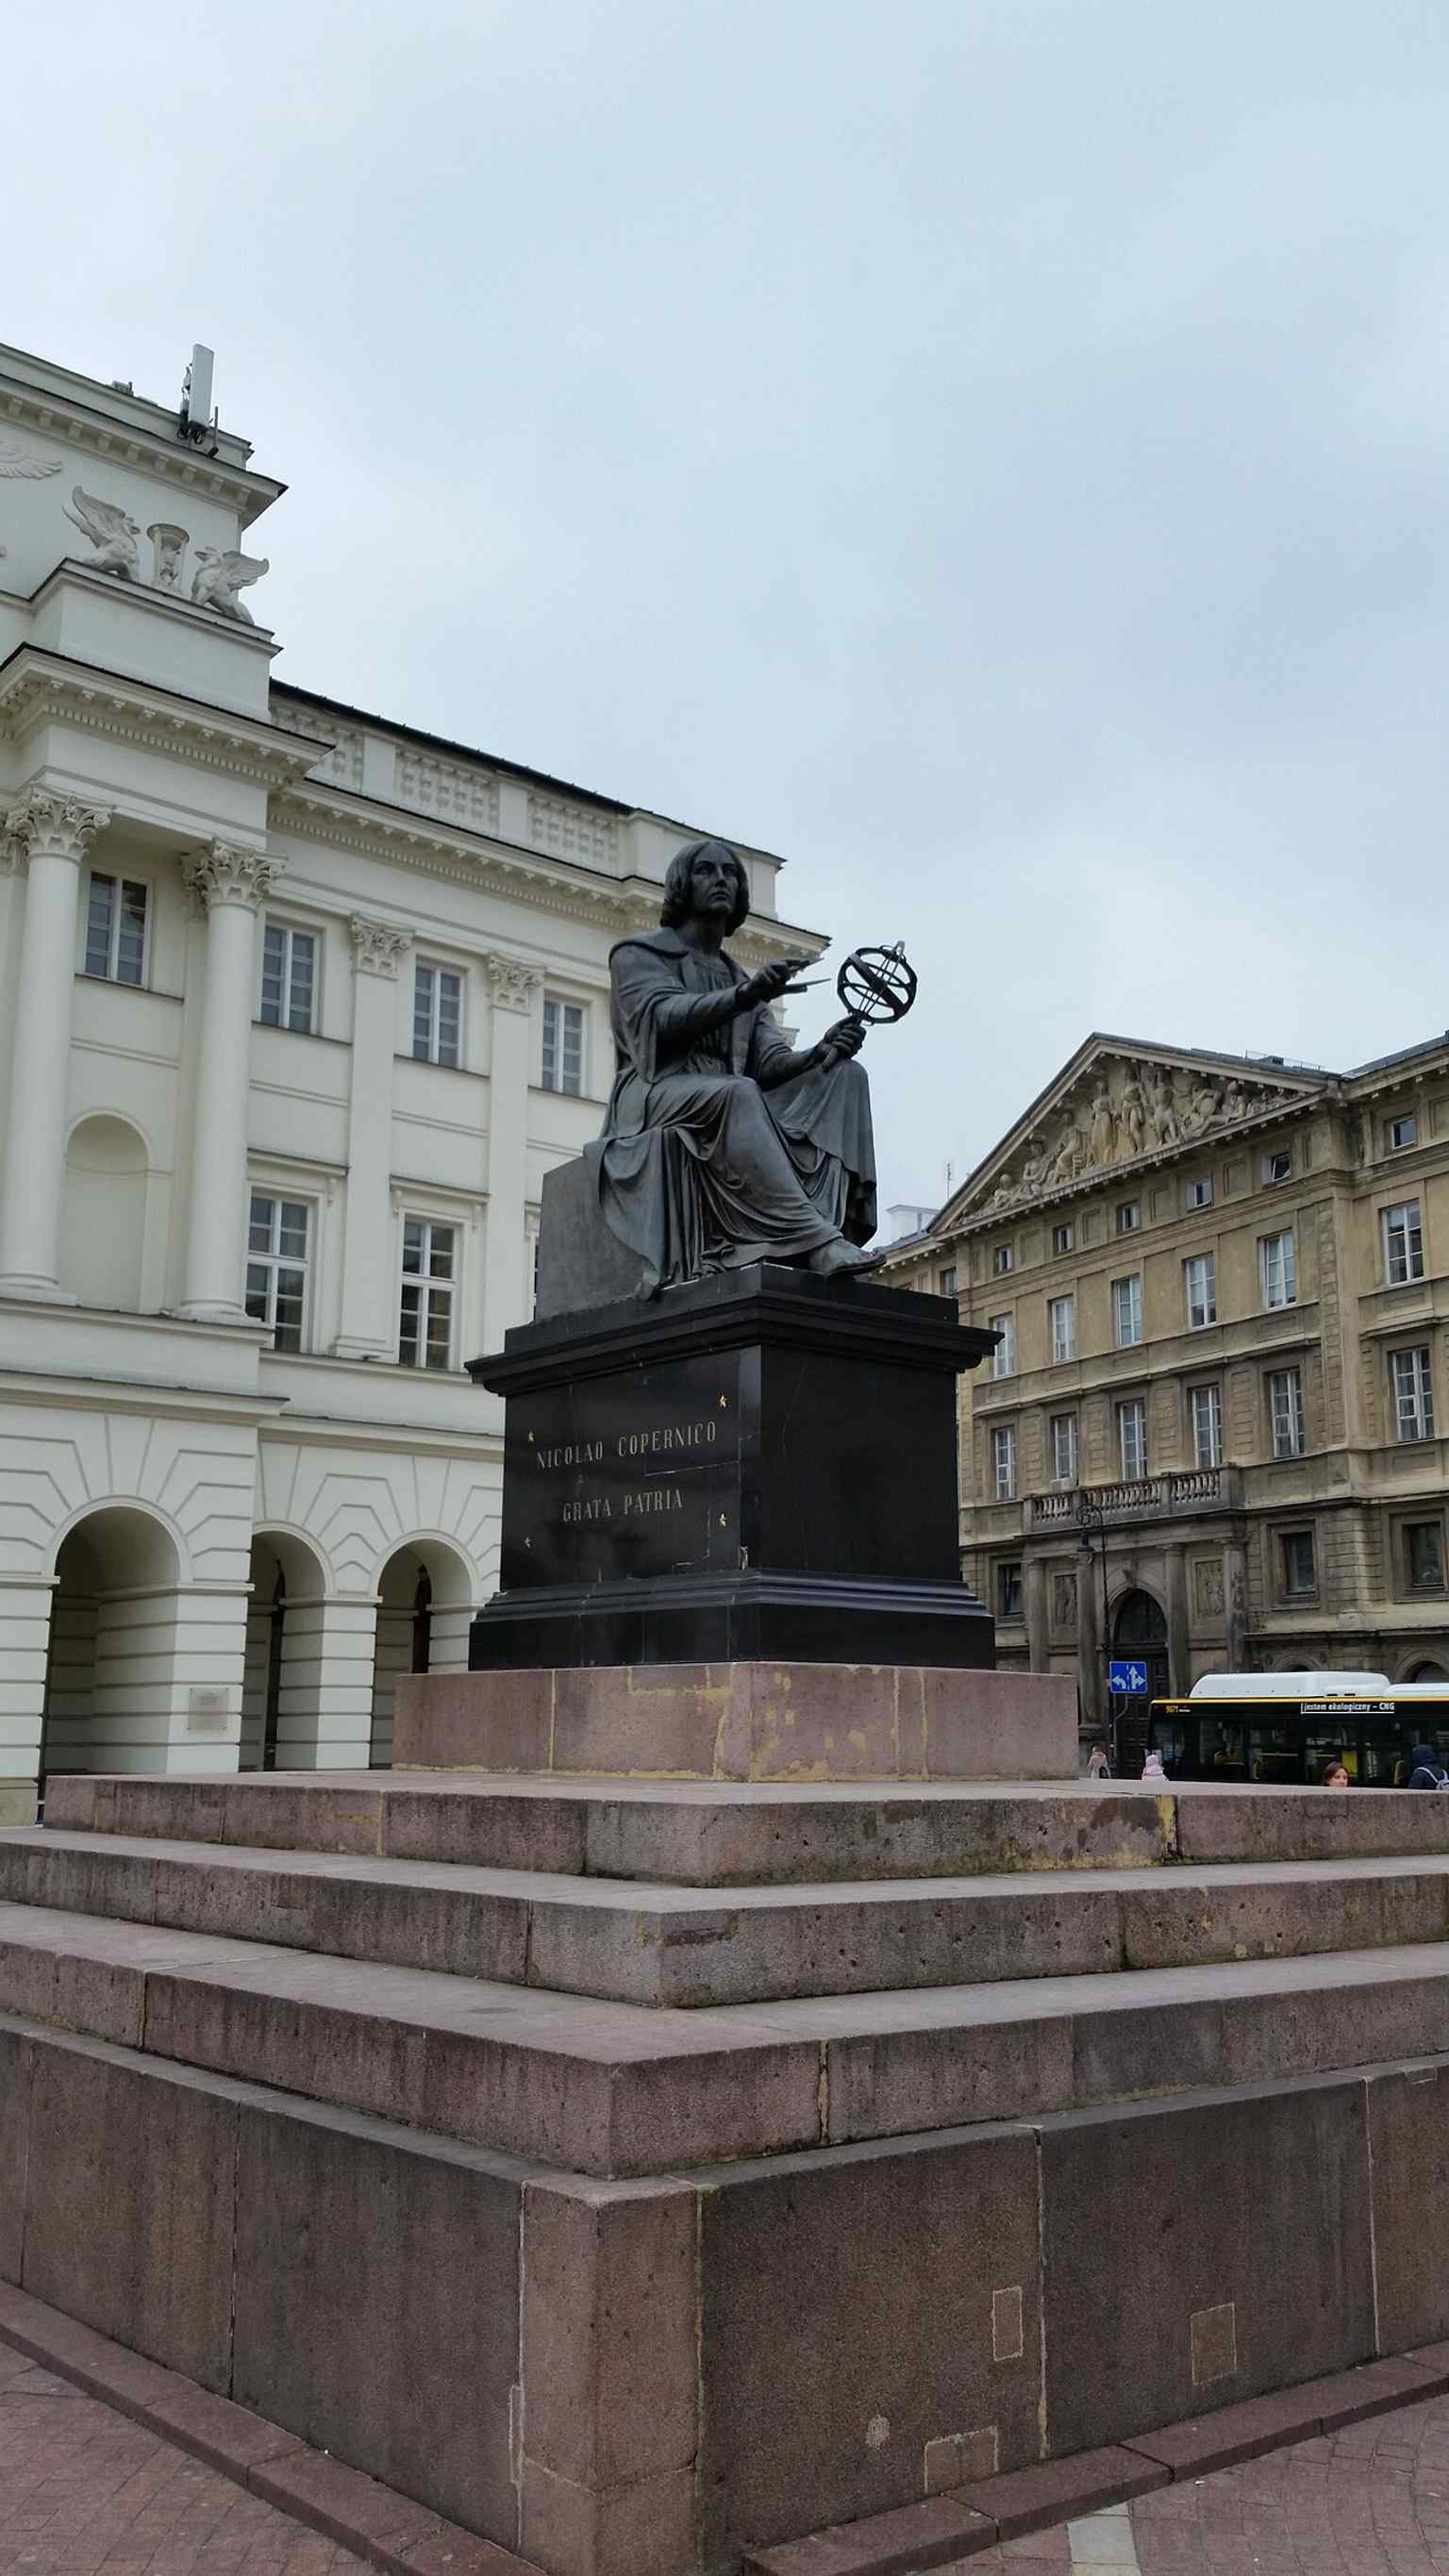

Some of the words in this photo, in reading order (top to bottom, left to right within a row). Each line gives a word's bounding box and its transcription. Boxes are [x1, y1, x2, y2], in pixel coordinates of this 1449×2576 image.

[536, 1440, 605, 1471] NICOLAO
[618, 1421, 717, 1457] COPERNICO
[562, 1498, 612, 1523] GRATA
[623, 1488, 683, 1516] PATRIA
